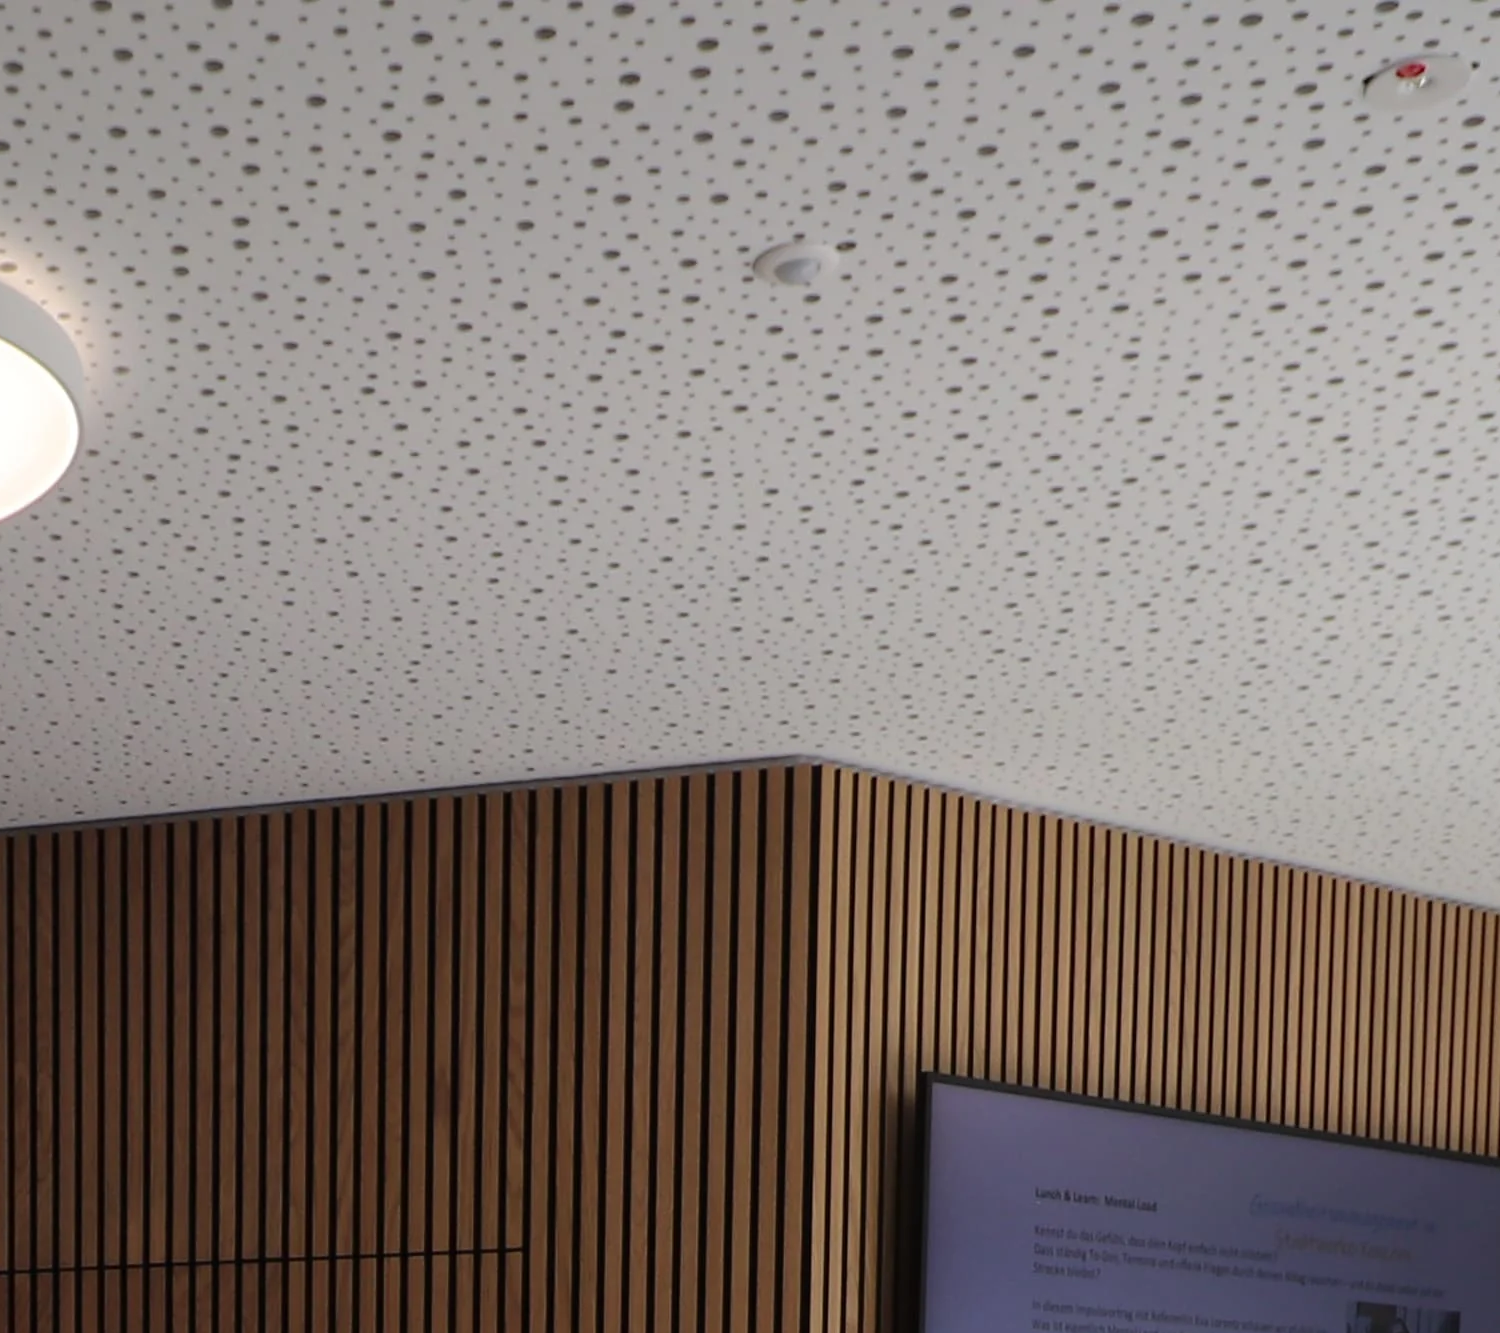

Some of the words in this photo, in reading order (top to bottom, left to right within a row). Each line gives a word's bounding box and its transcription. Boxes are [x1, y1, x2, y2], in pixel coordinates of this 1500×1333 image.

[1035, 1186, 1061, 1200] Lunch
[1063, 1189, 1070, 1201] &
[1104, 1194, 1135, 1208] Mental
[1137, 1198, 1157, 1211] Load
